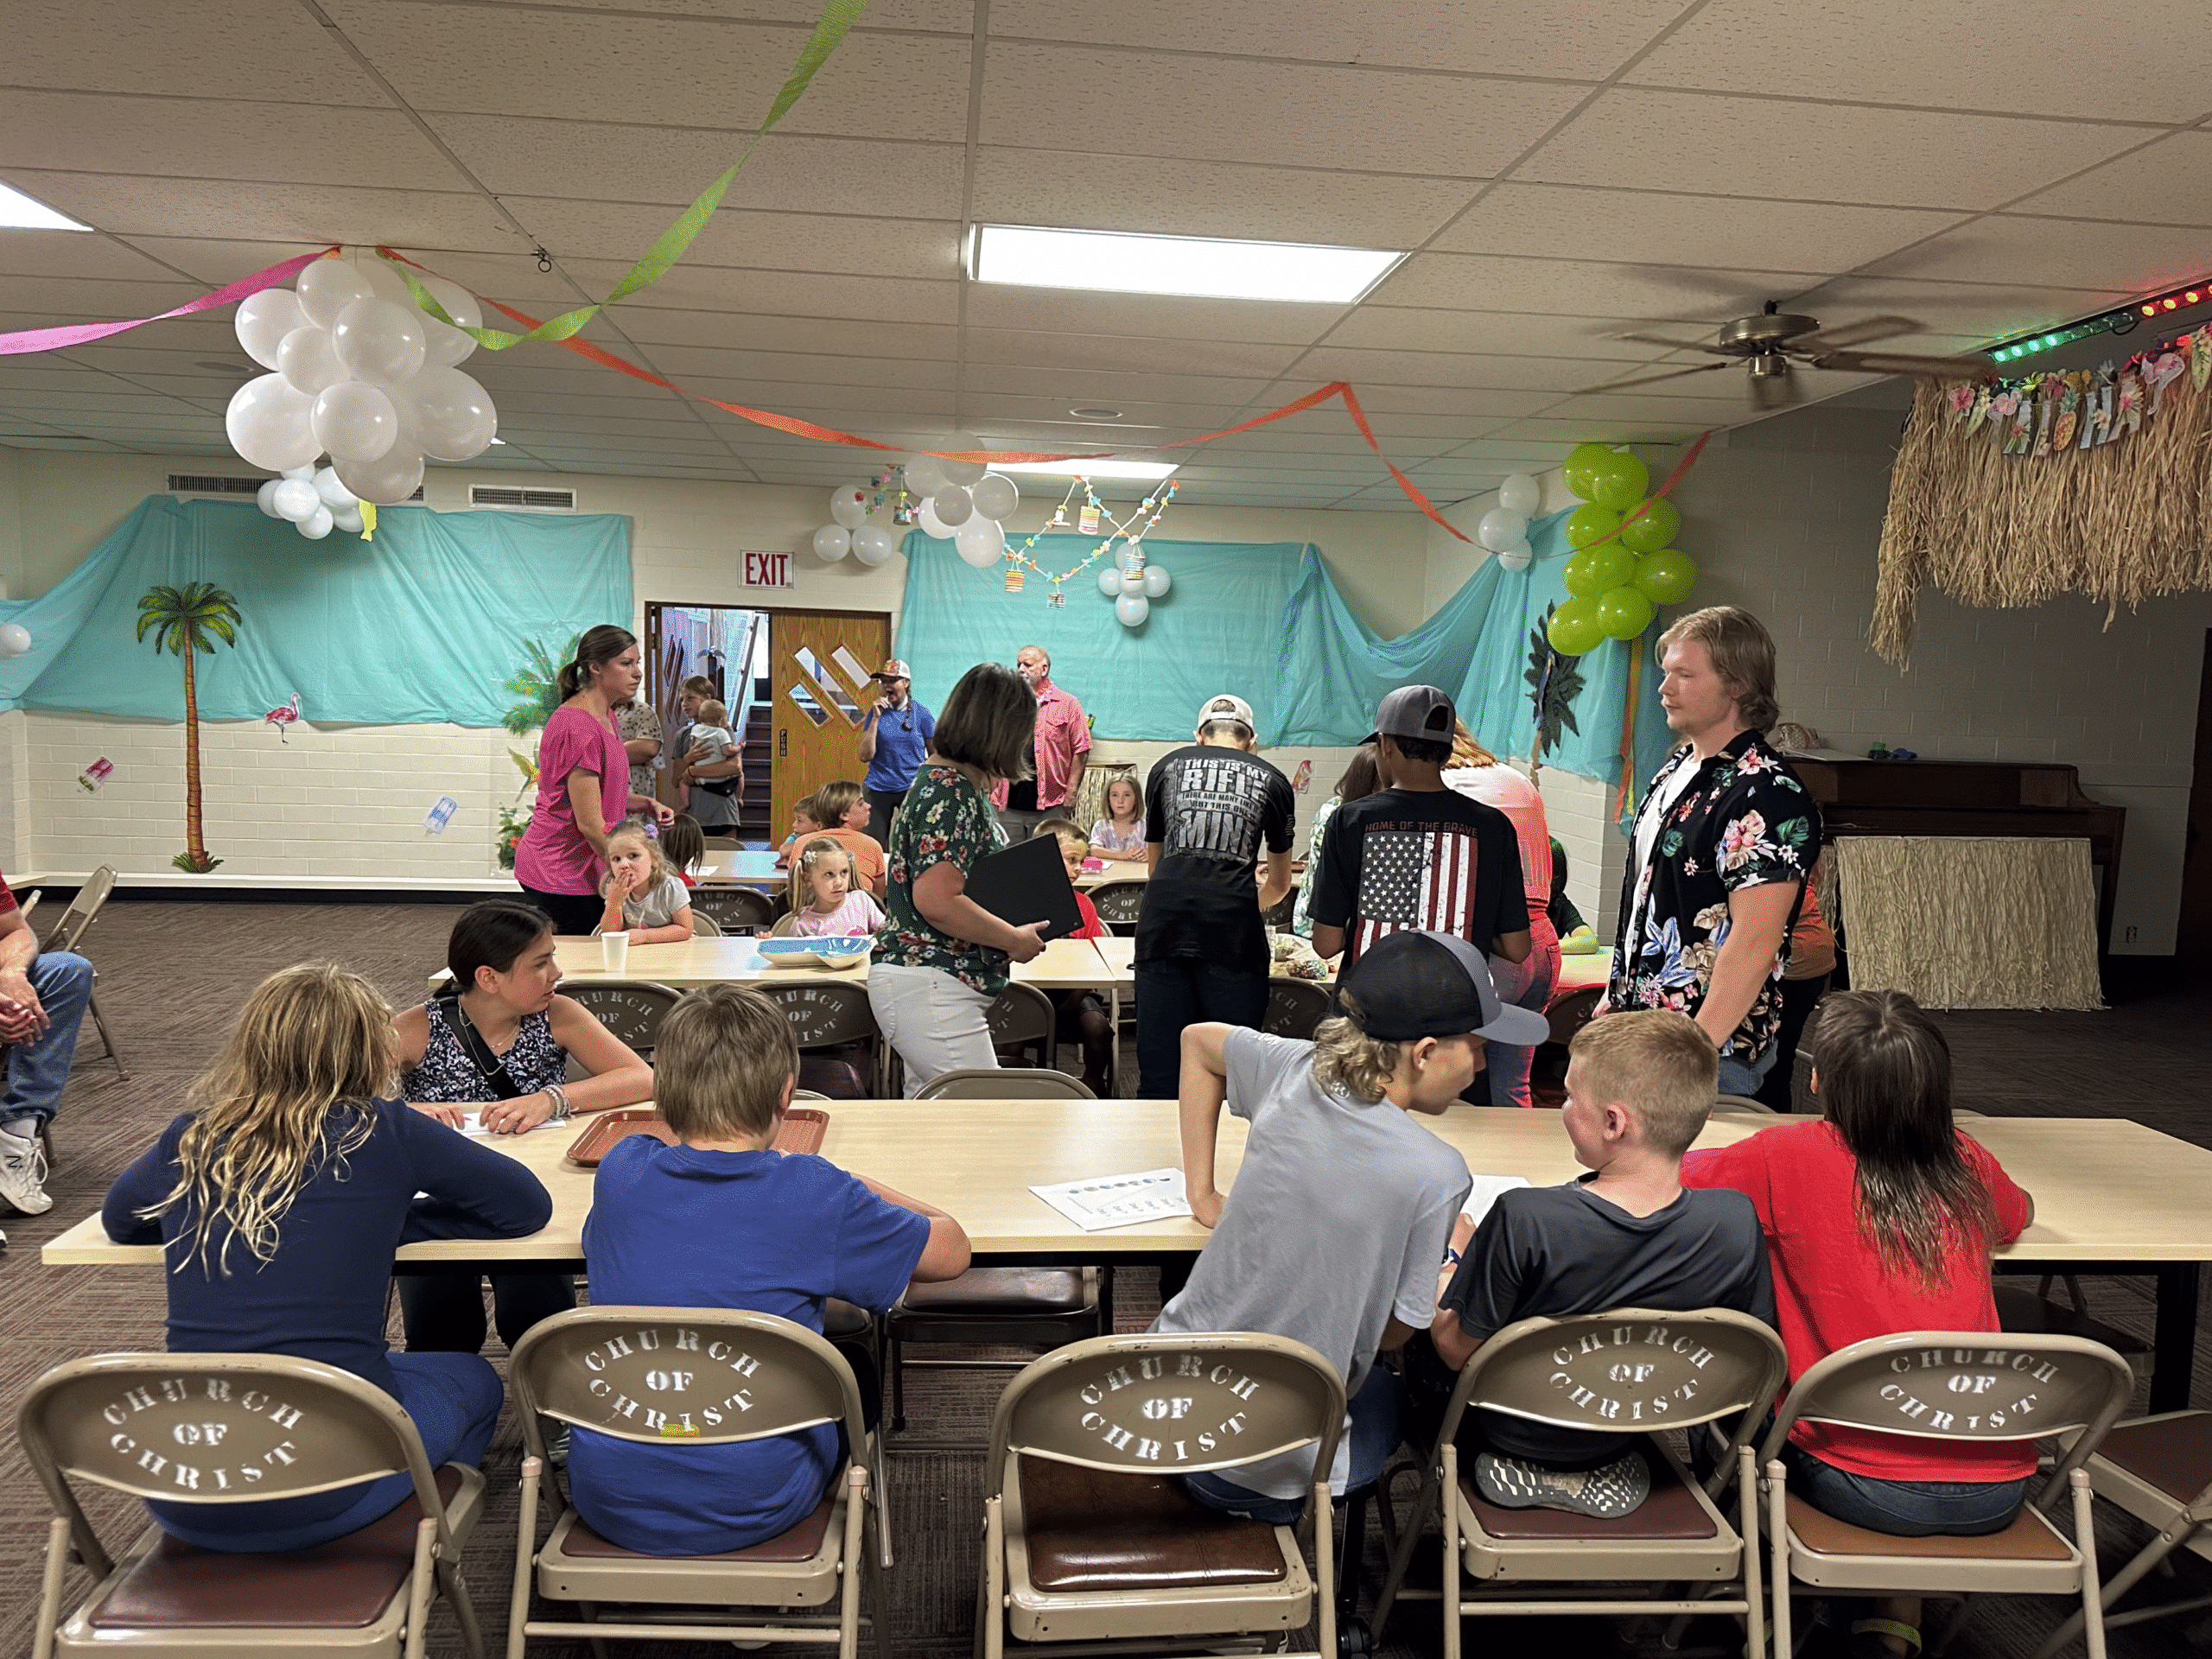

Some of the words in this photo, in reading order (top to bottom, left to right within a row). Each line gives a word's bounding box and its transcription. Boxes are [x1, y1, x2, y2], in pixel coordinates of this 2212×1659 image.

[745, 552, 789, 586] EXIT
[1185, 759, 1219, 769] THIS
[1224, 761, 1241, 772] IS
[1246, 766, 1268, 781] MY
[1180, 768, 1268, 806] RIFLE
[1191, 800, 1208, 809] BUT
[1211, 802, 1230, 810] THIS
[1217, 794, 1237, 803] MANY
[1239, 799, 1253, 809] LIKE
[1177, 810, 1255, 859] MINE
[1364, 821, 1396, 832] HOME
[1399, 821, 1414, 830] OF
[1417, 822, 1440, 831] THE
[1443, 822, 1478, 836] BRAVE
[705, 902, 723, 911] OF
[1103, 903, 1140, 920] CHRIS
[1121, 899, 1135, 907] OF
[596, 1012, 620, 1023] OF
[788, 1010, 812, 1022] OF
[584, 1328, 761, 1379] CHURCH
[1551, 1325, 1715, 1370] CHURCH
[1079, 1354, 1260, 1405] CHURCH
[1608, 1363, 1655, 1382] OF
[1890, 1350, 2061, 1384] CHURCH
[645, 1370, 693, 1391] OF
[1948, 1374, 1996, 1395] OF
[103, 1378, 304, 1430] CHURCH
[588, 1378, 755, 1433] CHRIST
[1549, 1371, 1699, 1420] CHRIST
[1880, 1383, 2038, 1432] CHRIST
[1141, 1397, 1192, 1420] OF
[173, 1421, 229, 1446] OF
[1081, 1411, 1249, 1461] CHRIST
[110, 1440, 298, 1490] CHRIST
